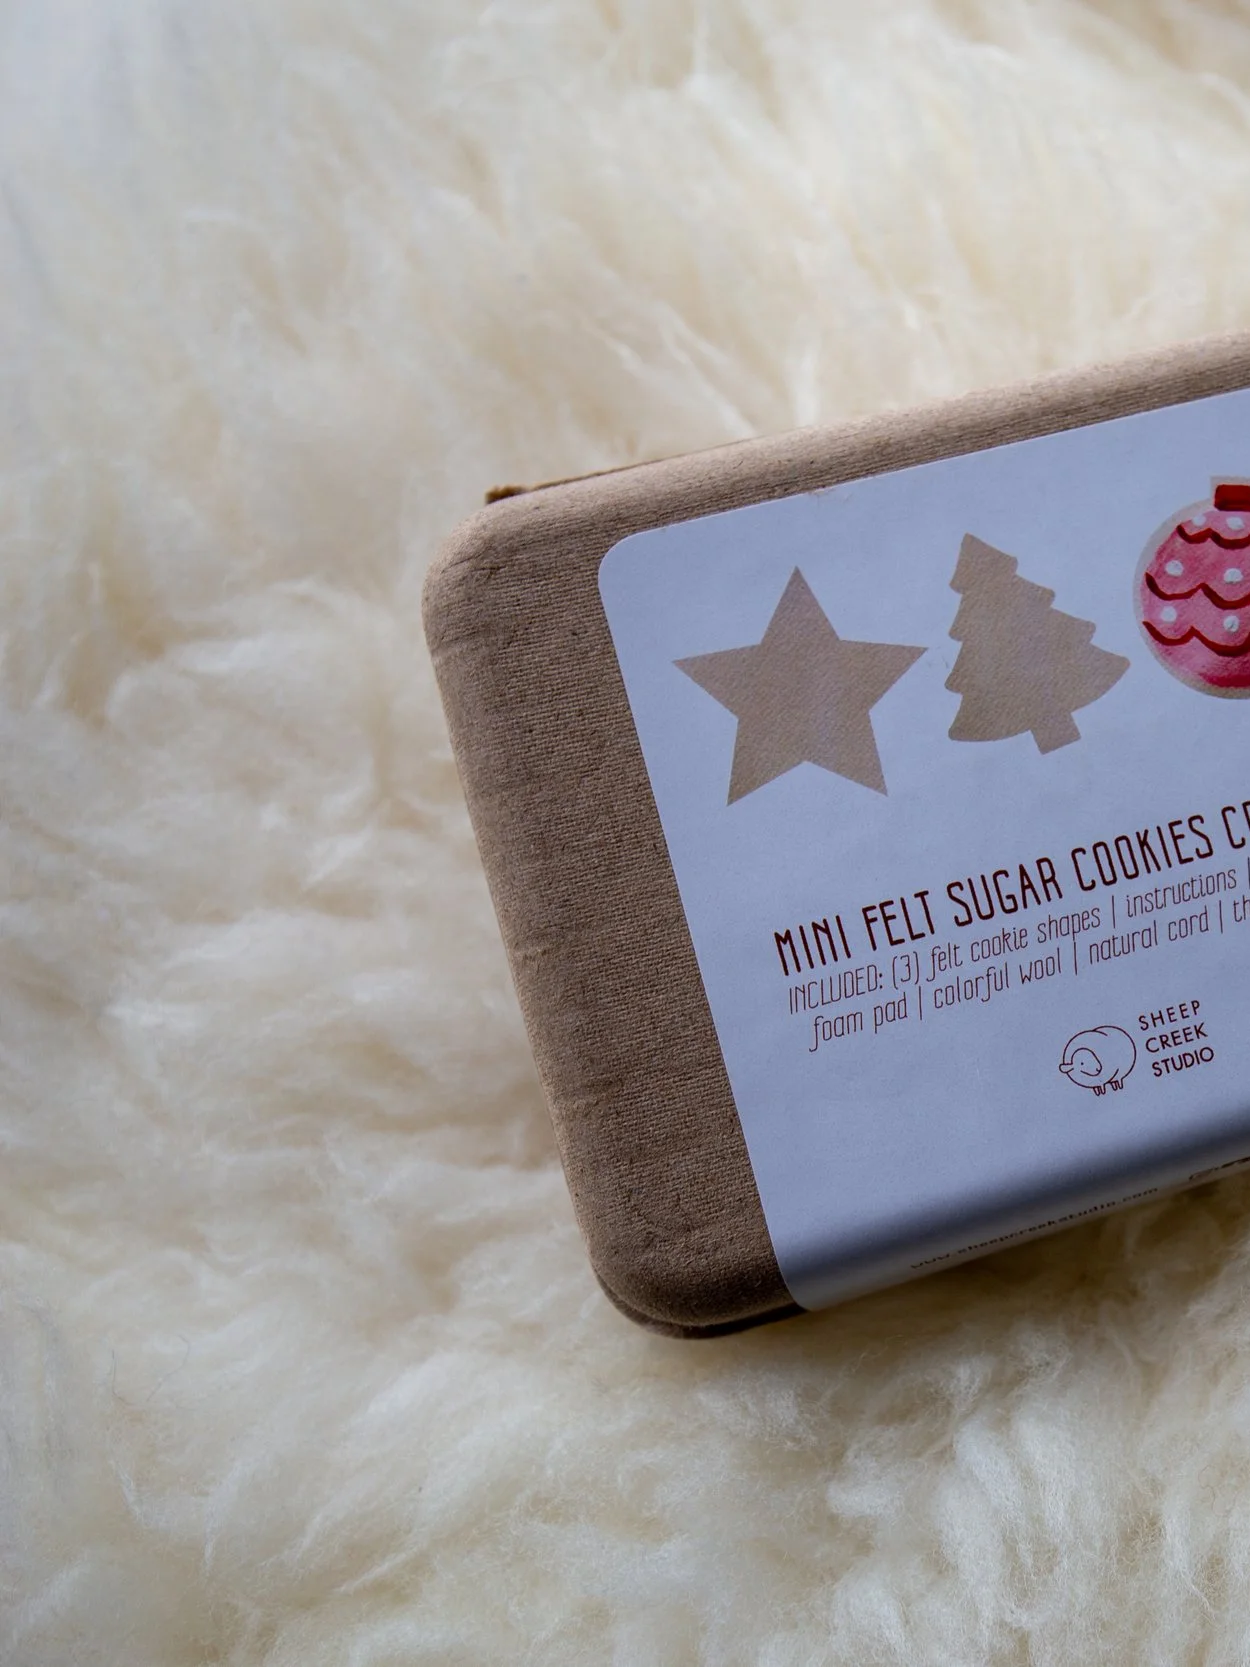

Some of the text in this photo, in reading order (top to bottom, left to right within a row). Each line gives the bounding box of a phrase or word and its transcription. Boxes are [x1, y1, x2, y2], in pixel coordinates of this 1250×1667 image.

[774, 915, 851, 976] MINI
[861, 890, 935, 951] FELT
[946, 857, 1063, 927] SUGAR
[1070, 815, 1214, 891] COOKIES
[789, 964, 883, 1015] INCLUDED:
[892, 951, 920, 990] (3)
[926, 942, 961, 982] felt
[970, 926, 1029, 963] cookie
[1037, 907, 1101, 941] shapes
[1126, 868, 1237, 918] instructions
[808, 1010, 864, 1053] foam
[874, 992, 908, 1034] pad
[934, 962, 1010, 1009] colorful
[1020, 947, 1062, 985] wool
[1089, 920, 1158, 965] natural
[1168, 905, 1209, 942] cord
[1138, 1000, 1200, 1031] SHEEP
[1145, 1022, 1208, 1053] CREEK
[1151, 1047, 1215, 1077] STUDIO
